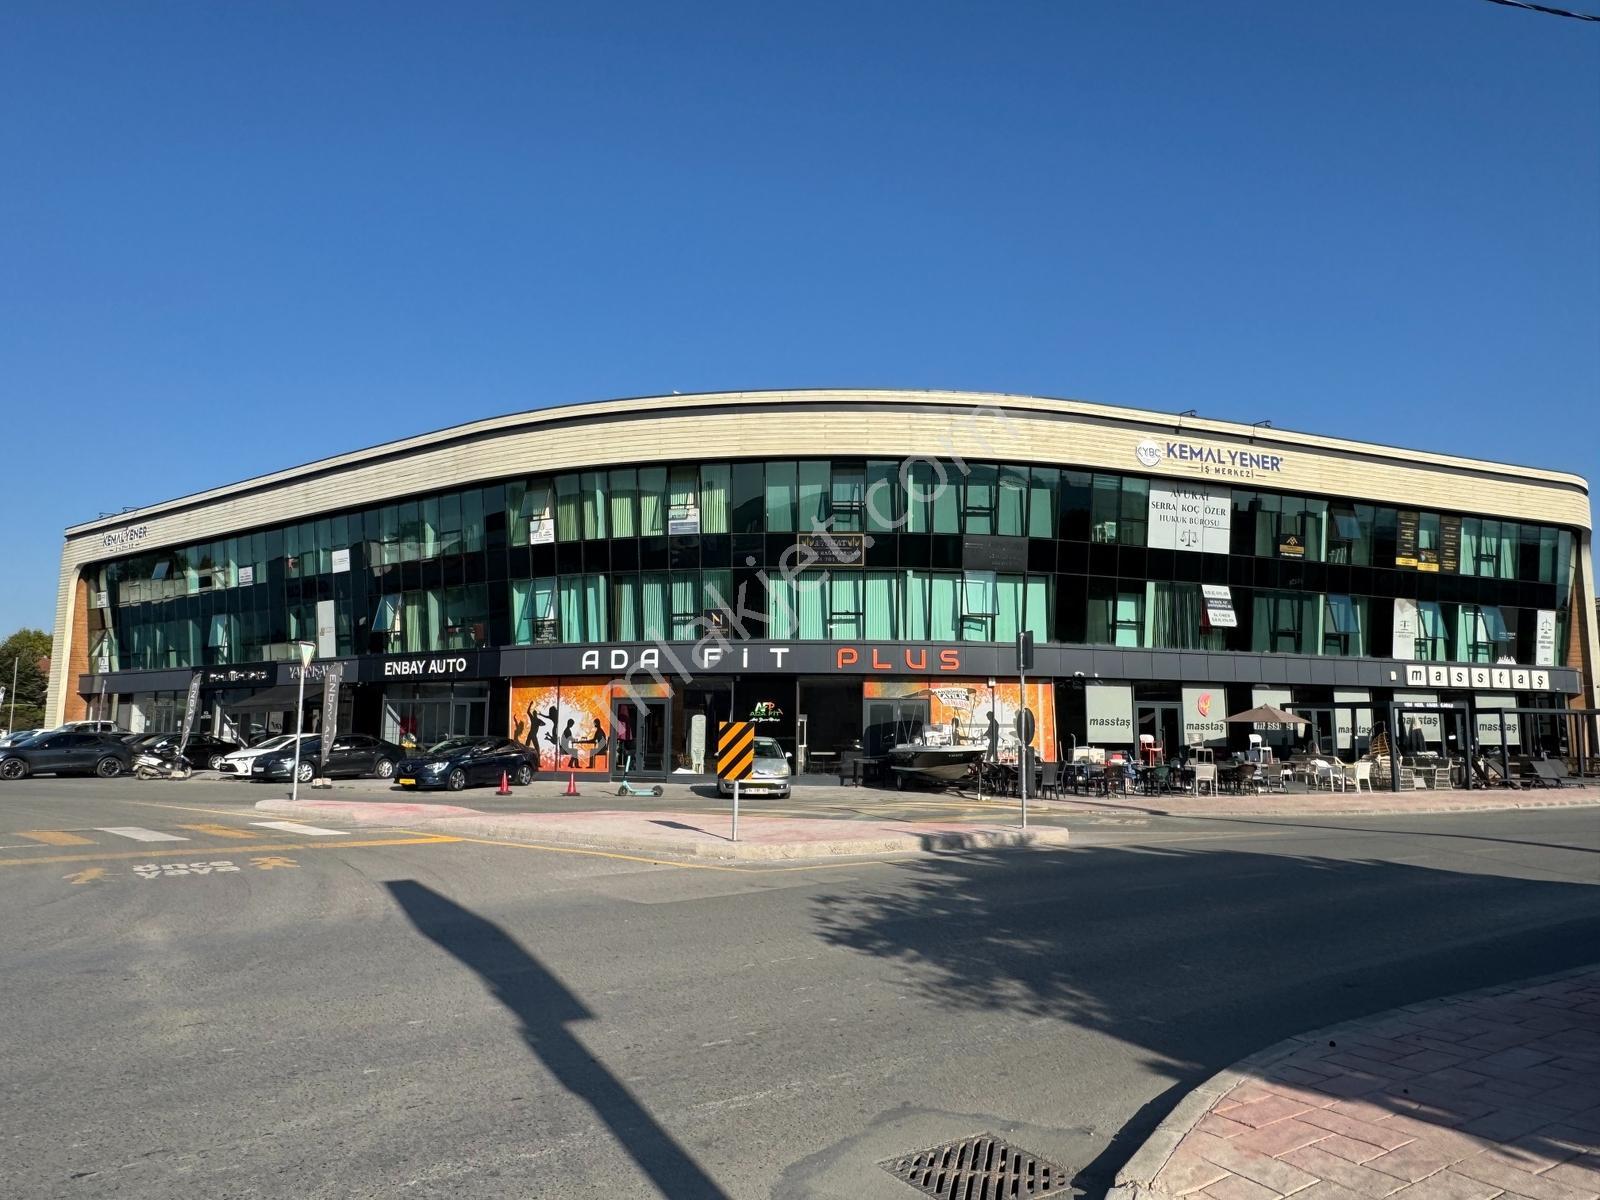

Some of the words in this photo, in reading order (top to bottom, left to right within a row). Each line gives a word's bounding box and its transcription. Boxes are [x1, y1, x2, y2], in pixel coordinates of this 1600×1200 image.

[1166, 442, 1226, 465] KEMAL
[1228, 449, 1281, 472] YENER
[1170, 489, 1210, 502] AVUKAT
[1151, 501, 1177, 511] SERRA
[1181, 504, 1200, 514] KOÇ
[1204, 505, 1227, 516] ÖZER
[1160, 515, 1187, 524] HUKUK
[384, 660, 426, 676] ENBAY
[428, 657, 467, 674] AUTO
[581, 649, 659, 670] ADA
[837, 648, 961, 670] PLUS
[1411, 670, 1545, 688] masstaş
[1089, 717, 1131, 729] masstaş
[1186, 721, 1225, 733] masstaş
